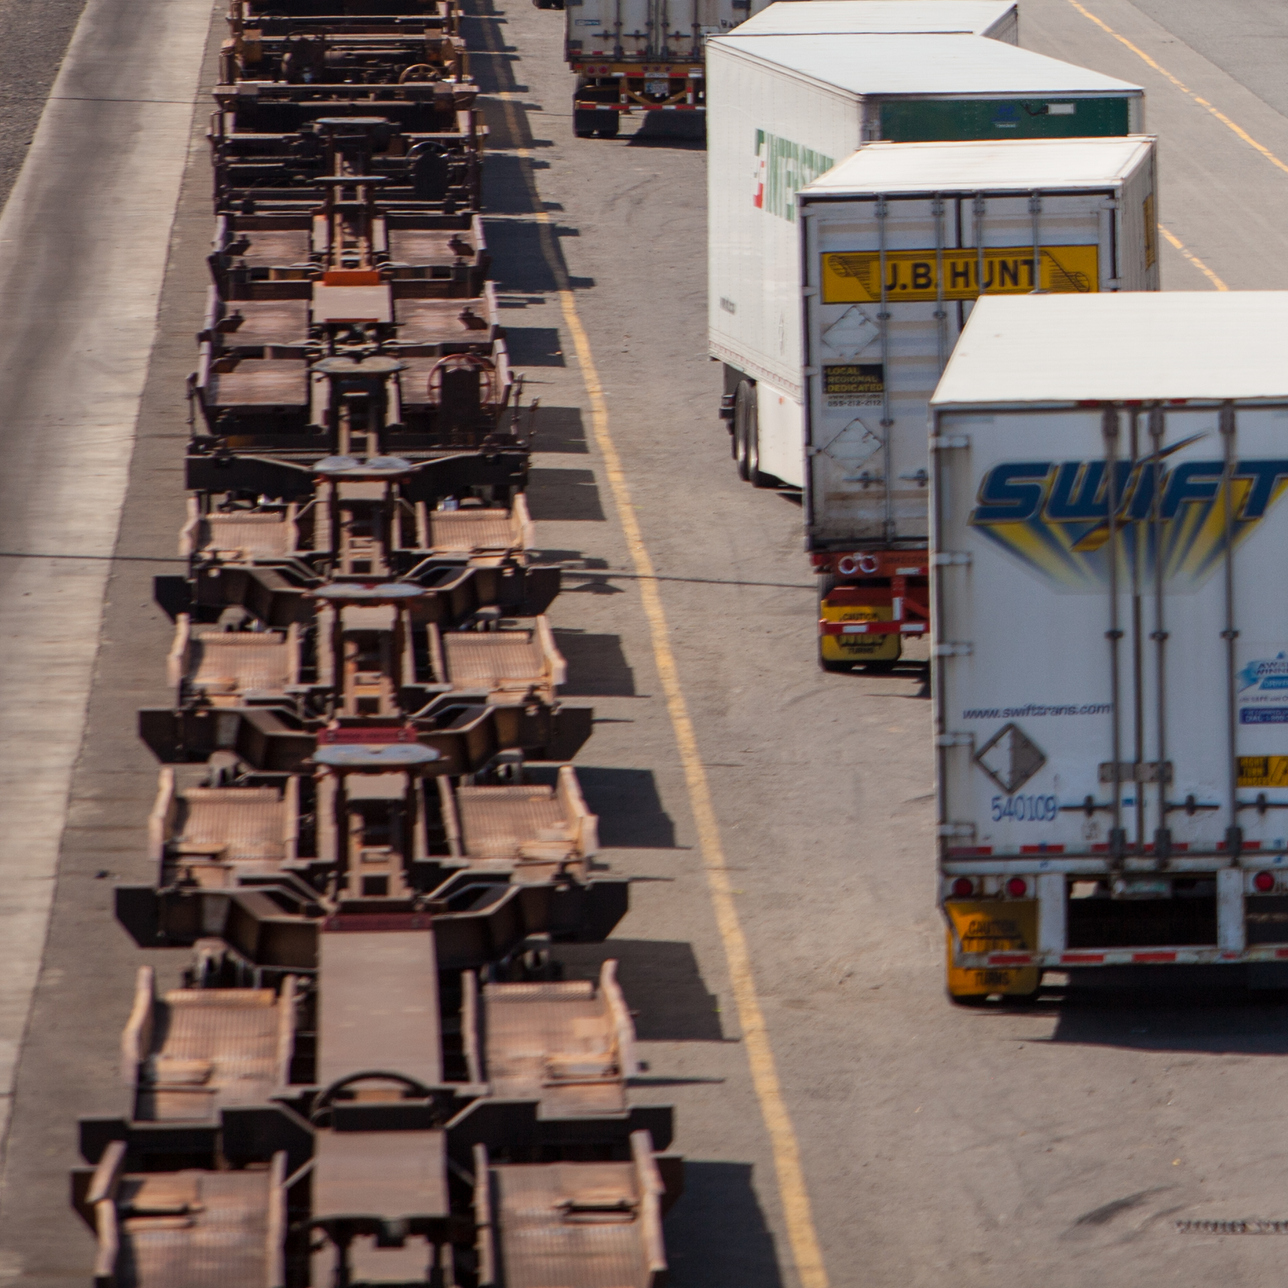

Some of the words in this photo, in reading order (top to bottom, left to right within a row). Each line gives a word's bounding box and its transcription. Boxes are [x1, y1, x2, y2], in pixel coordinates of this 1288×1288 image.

[952, 259, 1041, 290] HUNT
[827, 367, 859, 375] LOCAL
[827, 375, 877, 383] REGIONAL
[827, 384, 883, 392] DEDICATED
[991, 794, 1056, 822] 540109
